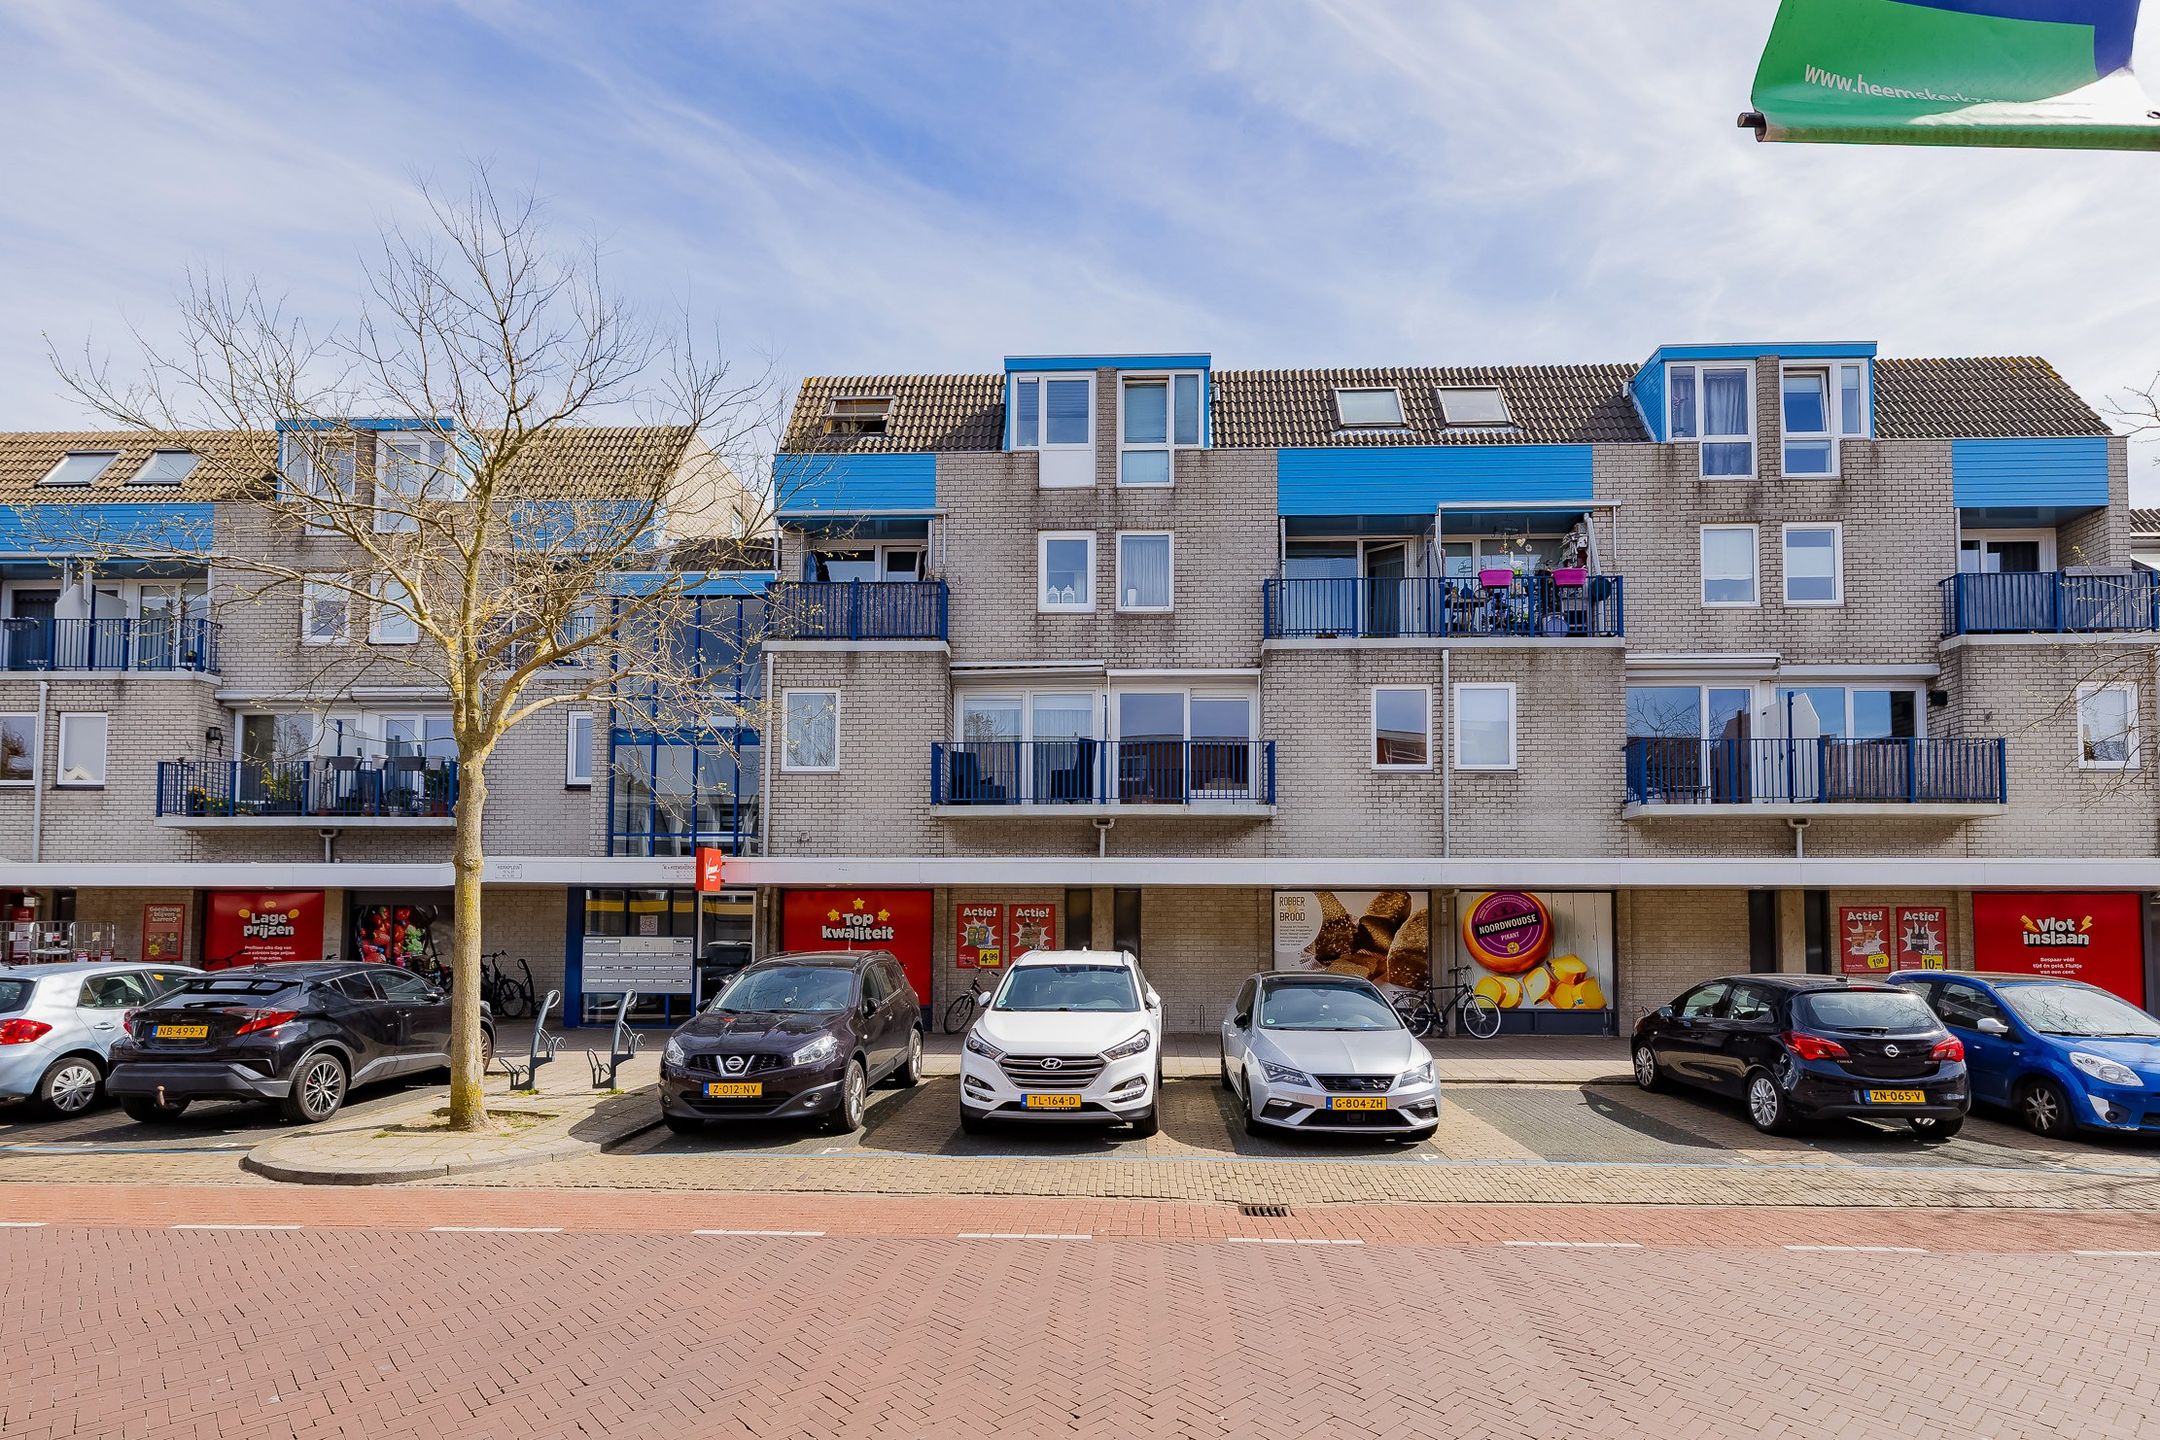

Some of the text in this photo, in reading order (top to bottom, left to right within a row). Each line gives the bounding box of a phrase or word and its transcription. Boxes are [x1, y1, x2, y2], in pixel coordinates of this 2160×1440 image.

[1279, 896, 1305, 907] ROBBER
[963, 907, 997, 917] Actie!
[1015, 907, 1050, 918] Actie!
[1279, 912, 1306, 921] BROOD
[1847, 911, 1883, 921] Actie!
[1903, 911, 1940, 921] Actie!
[251, 912, 288, 925] Lage
[842, 913, 874, 927] Top
[1478, 913, 1537, 935] NOORDWOUDSE
[2036, 916, 2075, 932] Vlot
[243, 925, 295, 939] prijzen
[821, 925, 895, 940] kwaliteit
[1500, 931, 1520, 941] PIKANT
[2022, 931, 2090, 945] inslaan
[158, 1026, 205, 1036] NB-499-X
[713, 1085, 757, 1094] Z-012-NV
[1032, 1095, 1076, 1106] TL-164-D
[1872, 1091, 1921, 1101] ZN-065-V
[1335, 1098, 1383, 1108] G-804-ZH
